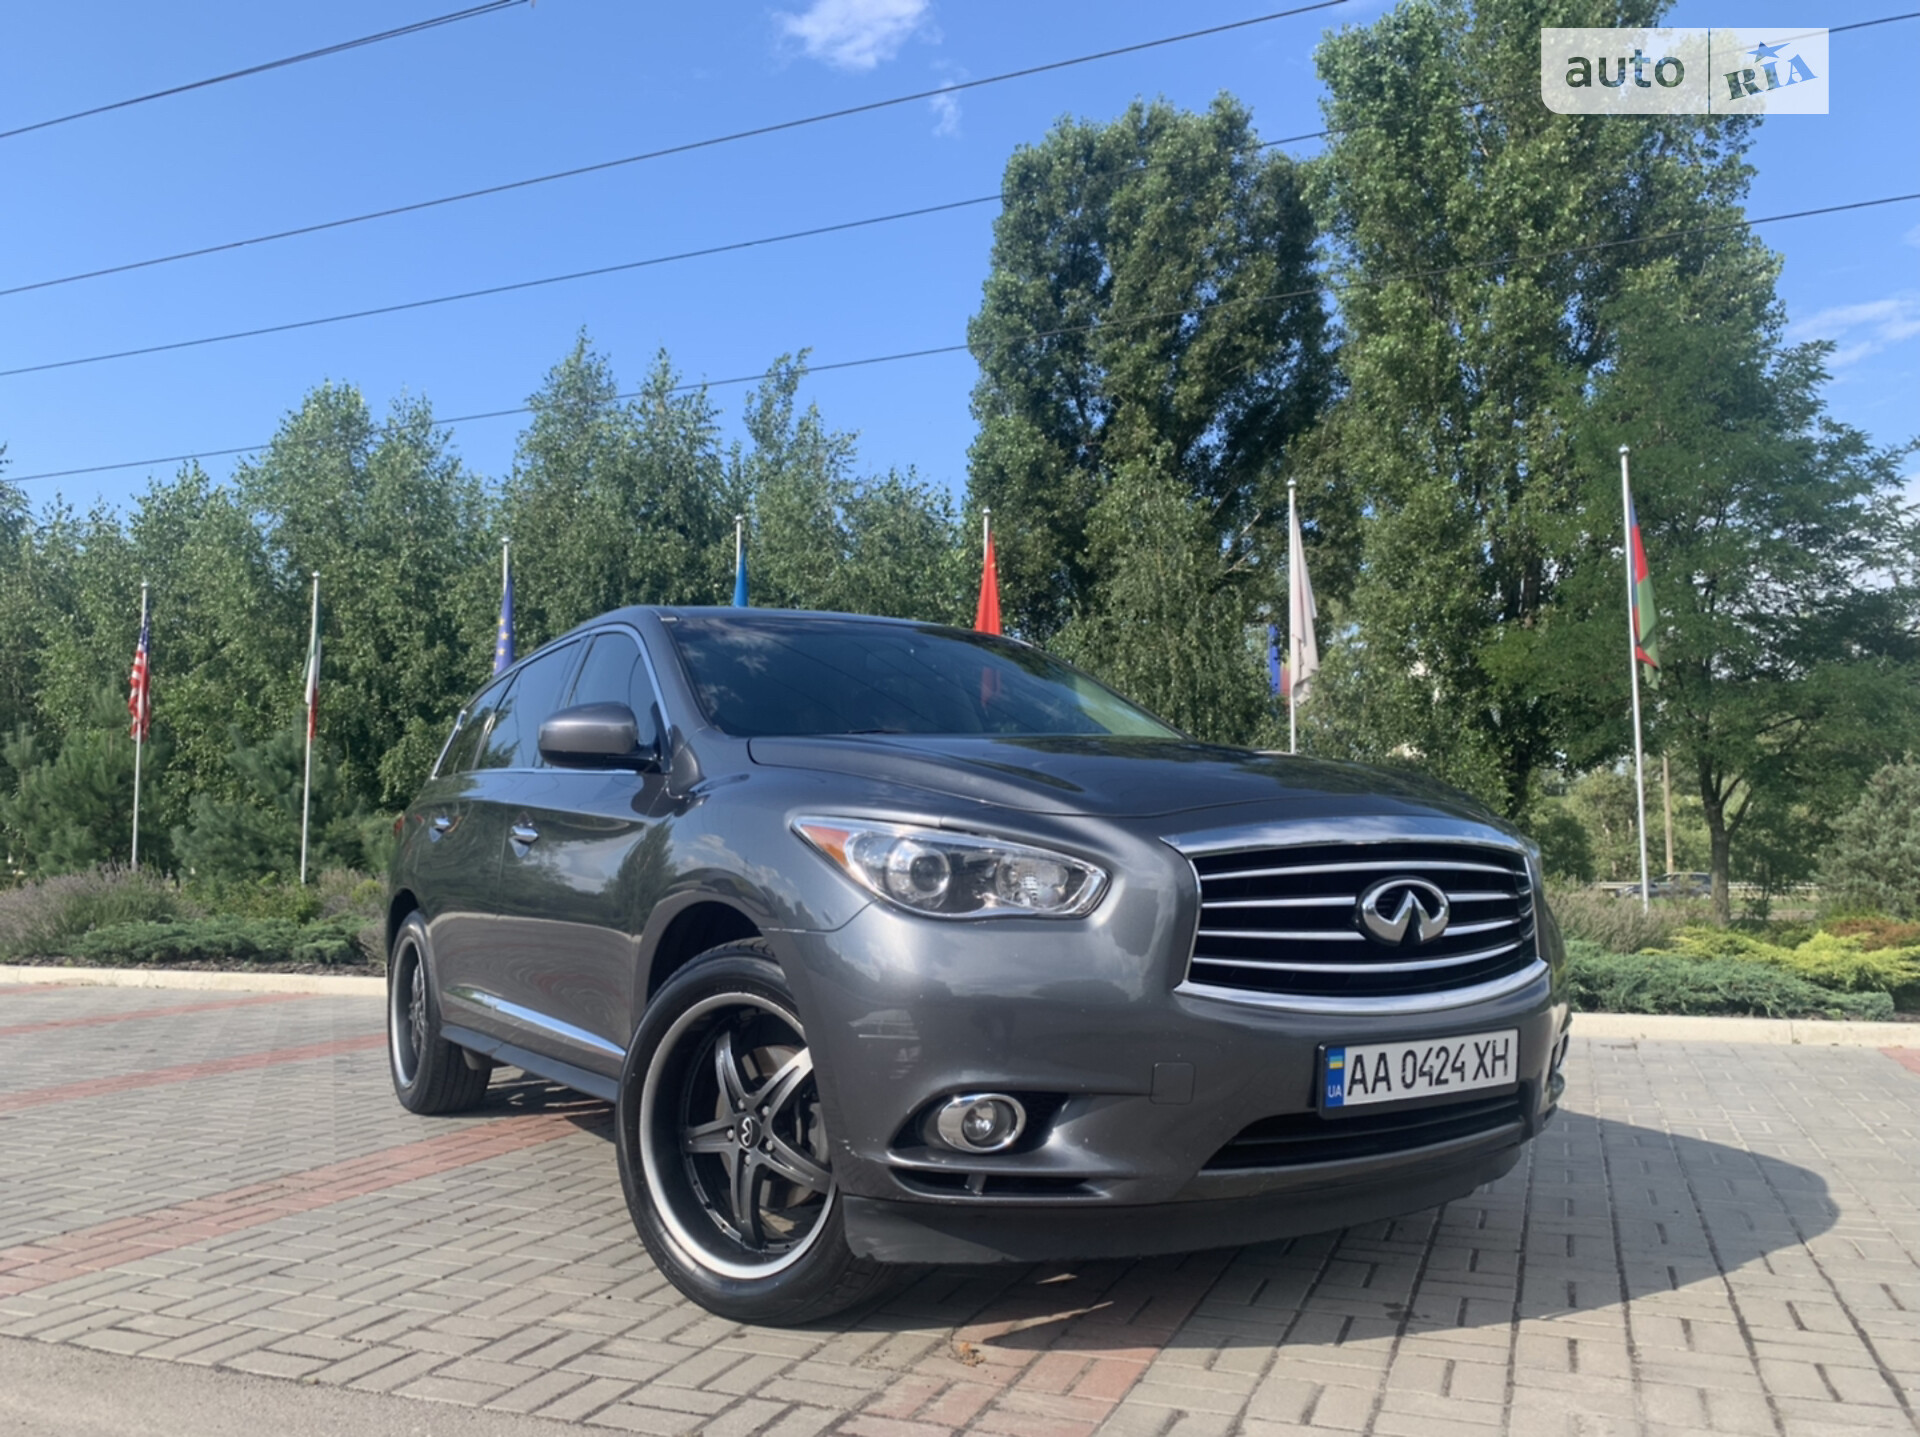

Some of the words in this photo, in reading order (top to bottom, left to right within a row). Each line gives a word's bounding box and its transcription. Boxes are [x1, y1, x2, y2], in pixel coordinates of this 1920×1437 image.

[1347, 1052, 1392, 1096] AA
[1401, 1043, 1466, 1089] 0424
[1473, 1038, 1509, 1081] XH
[1327, 1085, 1342, 1098] UA
